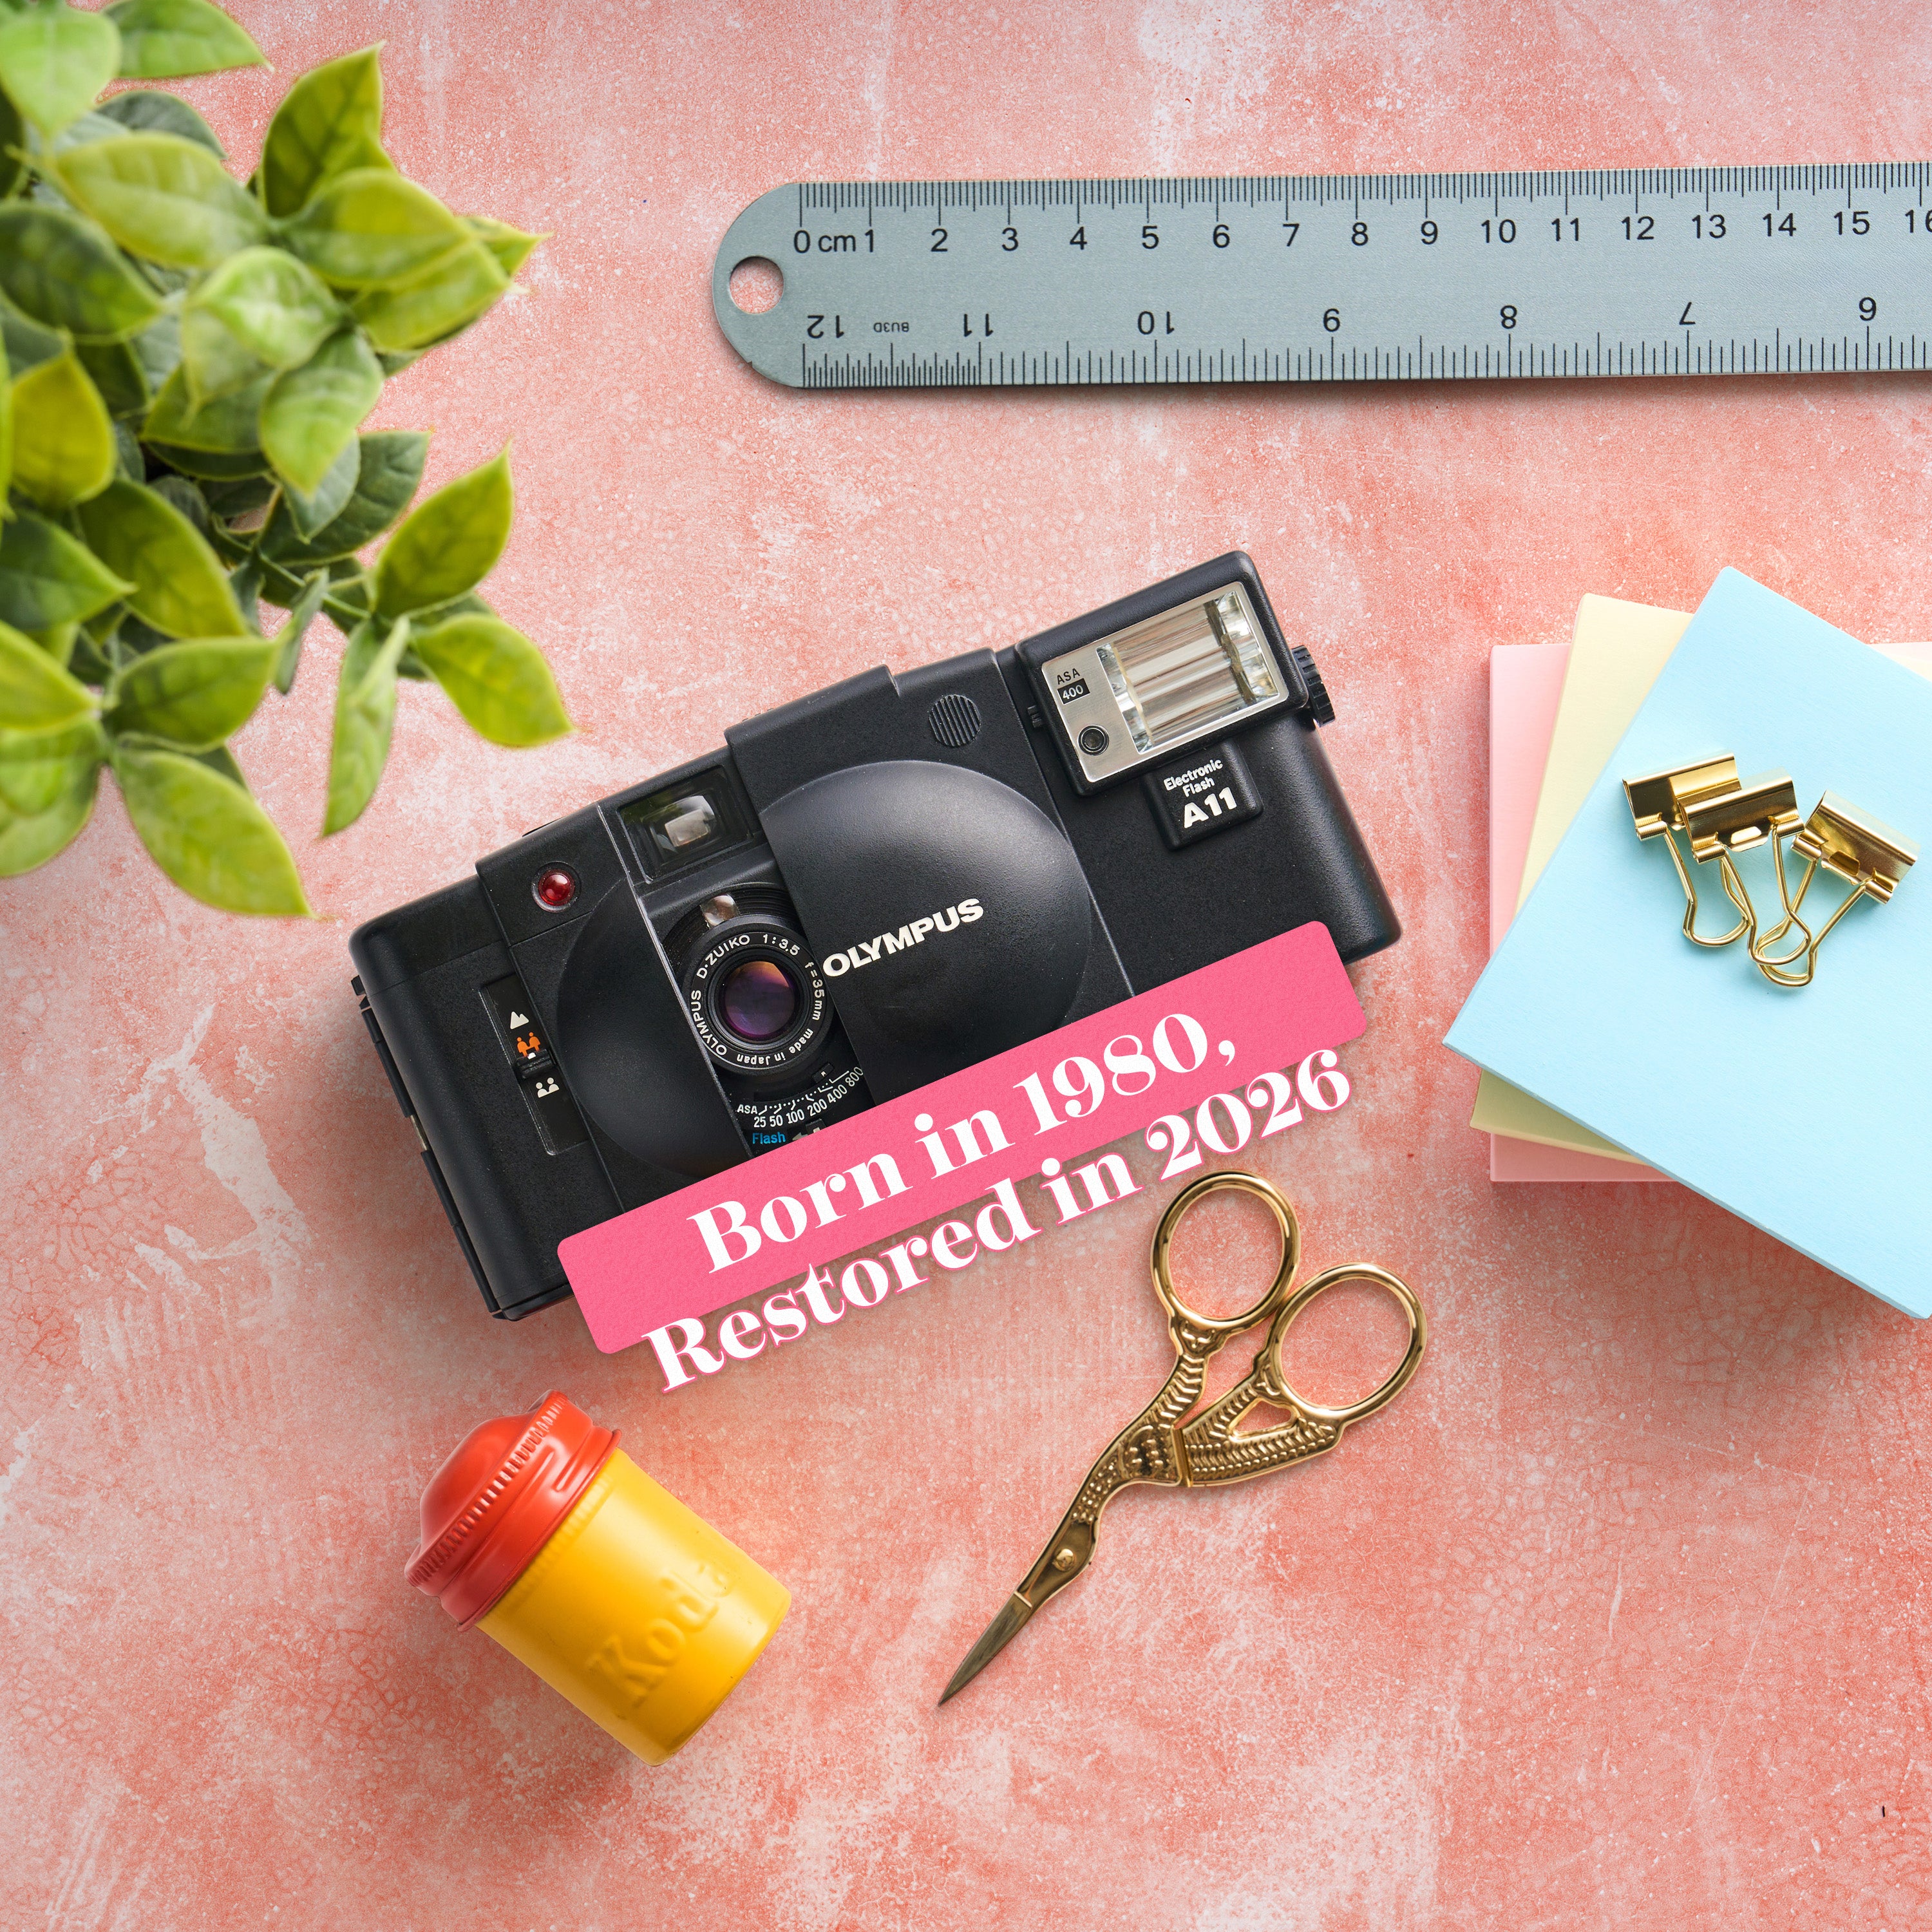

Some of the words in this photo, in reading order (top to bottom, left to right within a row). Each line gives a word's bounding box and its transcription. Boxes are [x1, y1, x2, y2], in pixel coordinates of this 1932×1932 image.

[794, 231, 810, 253] 0
[819, 235, 856, 252] cm
[865, 229, 873, 252] 1
[931, 229, 947, 252] 2
[1002, 227, 1018, 251] 3
[1070, 227, 1087, 250] 4
[1142, 226, 1159, 249] 5
[1213, 225, 1229, 248] 6
[1283, 223, 1300, 247] 7
[1352, 222, 1368, 246] 8
[1421, 221, 1437, 245] 9
[1482, 220, 1516, 243] 10
[1551, 218, 1578, 242] 11
[1622, 216, 1654, 240] 12
[1692, 214, 1726, 238] 13
[1763, 213, 1796, 236] 14
[1834, 211, 1870, 235] 15
[1138, 311, 1174, 335] 10
[1501, 305, 1517, 329] 8
[1680, 302, 1696, 325] 7
[808, 316, 844, 339] 12
[873, 322, 909, 332] BU3D
[964, 314, 993, 337] 11
[1057, 668, 1080, 684] ASA
[1063, 685, 1083, 700] 400
[1164, 759, 1223, 791] Electronic
[1183, 777, 1215, 797] Flash
[1184, 787, 1237, 828] A11
[823, 898, 983, 976] OLYMPUS
[691, 990, 727, 1056] OLYMPUS
[789, 1028, 813, 1053] made
[737, 1054, 770, 1065] Japan
[774, 1052, 786, 1061] in
[754, 1117, 766, 1127] 25
[770, 1115, 782, 1127] 50
[786, 1109, 804, 1124] 100
[808, 1099, 827, 1116] 200
[828, 1084, 847, 1103] 400
[846, 1066, 864, 1087] 800
[737, 1104, 757, 1114] ASA
[752, 1132, 786, 1144] Flash
